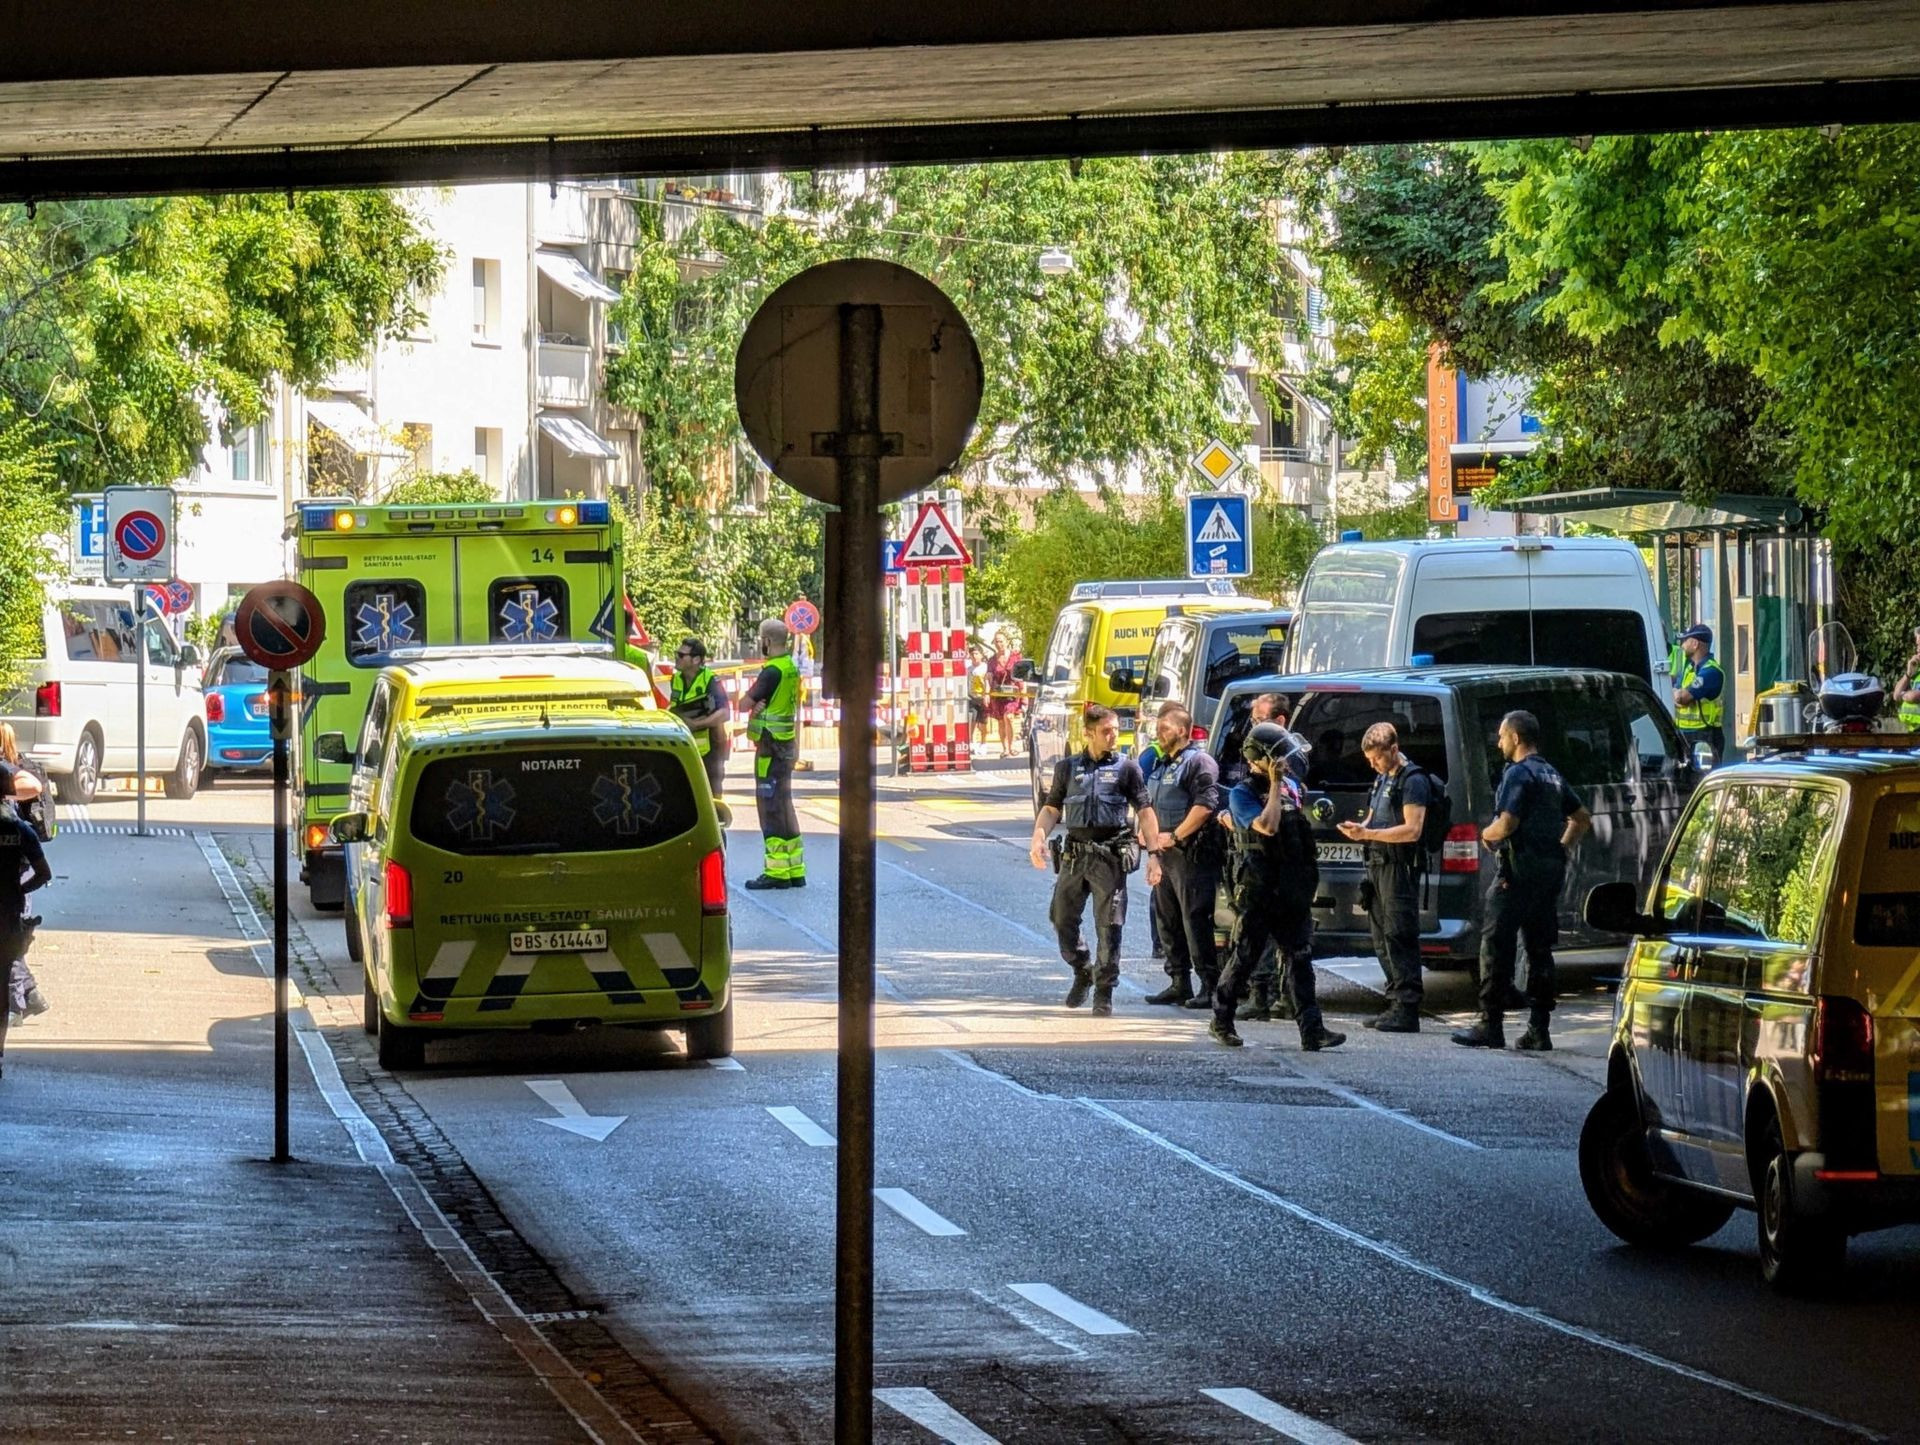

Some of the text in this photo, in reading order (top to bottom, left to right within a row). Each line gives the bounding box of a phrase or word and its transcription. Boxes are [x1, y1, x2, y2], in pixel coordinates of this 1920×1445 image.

[1437, 345, 1450, 517] ASENEGG
[531, 548, 555, 563] 14
[1114, 628, 1138, 639] AUCH
[908, 651, 922, 660] ab
[930, 650, 944, 660] ab
[952, 649, 966, 659] ab
[912, 743, 925, 753] ab
[934, 743, 948, 753] ab
[955, 741, 969, 752] ab
[521, 759, 582, 771] NOTARZT
[443, 871, 464, 884] 20
[440, 912, 500, 925] RETTUNG
[503, 910, 591, 923] BASEL-STADT
